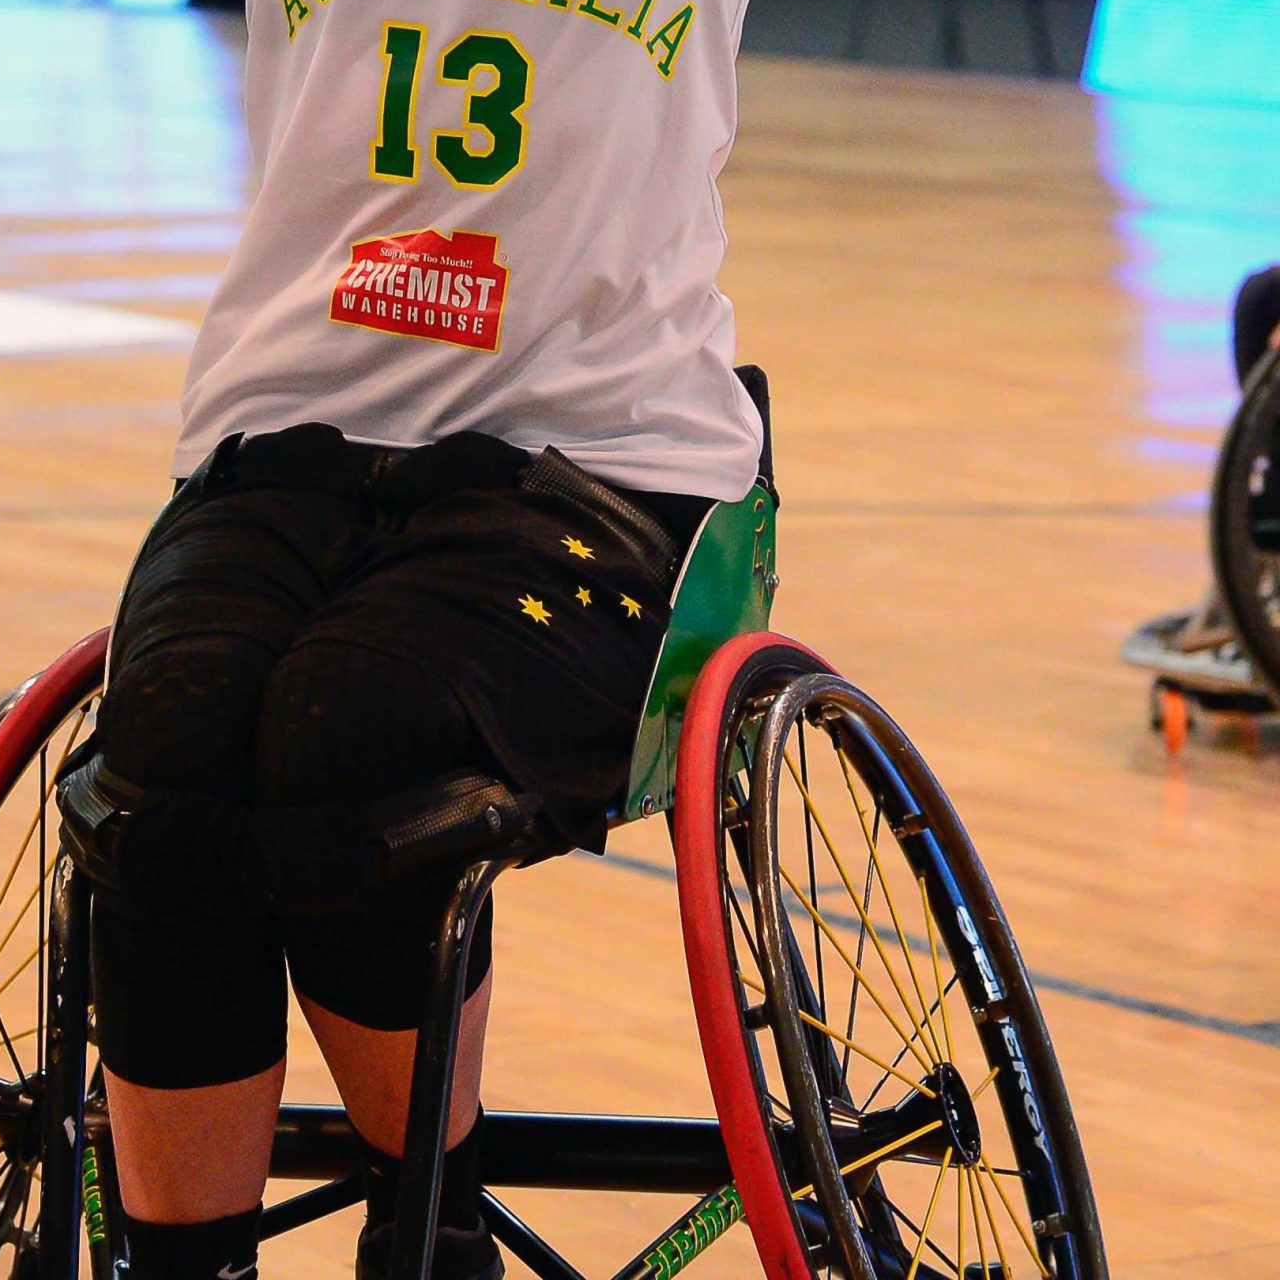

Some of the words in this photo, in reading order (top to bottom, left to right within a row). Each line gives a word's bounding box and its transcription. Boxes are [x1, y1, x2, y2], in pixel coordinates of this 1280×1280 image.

[369, 20, 534, 191] 13
[380, 247, 397, 260] Stop
[422, 252, 438, 264] Too
[440, 256, 473, 269] Much!!
[347, 258, 497, 312] CHEMIST
[342, 292, 484, 334] WAREHOUSE
